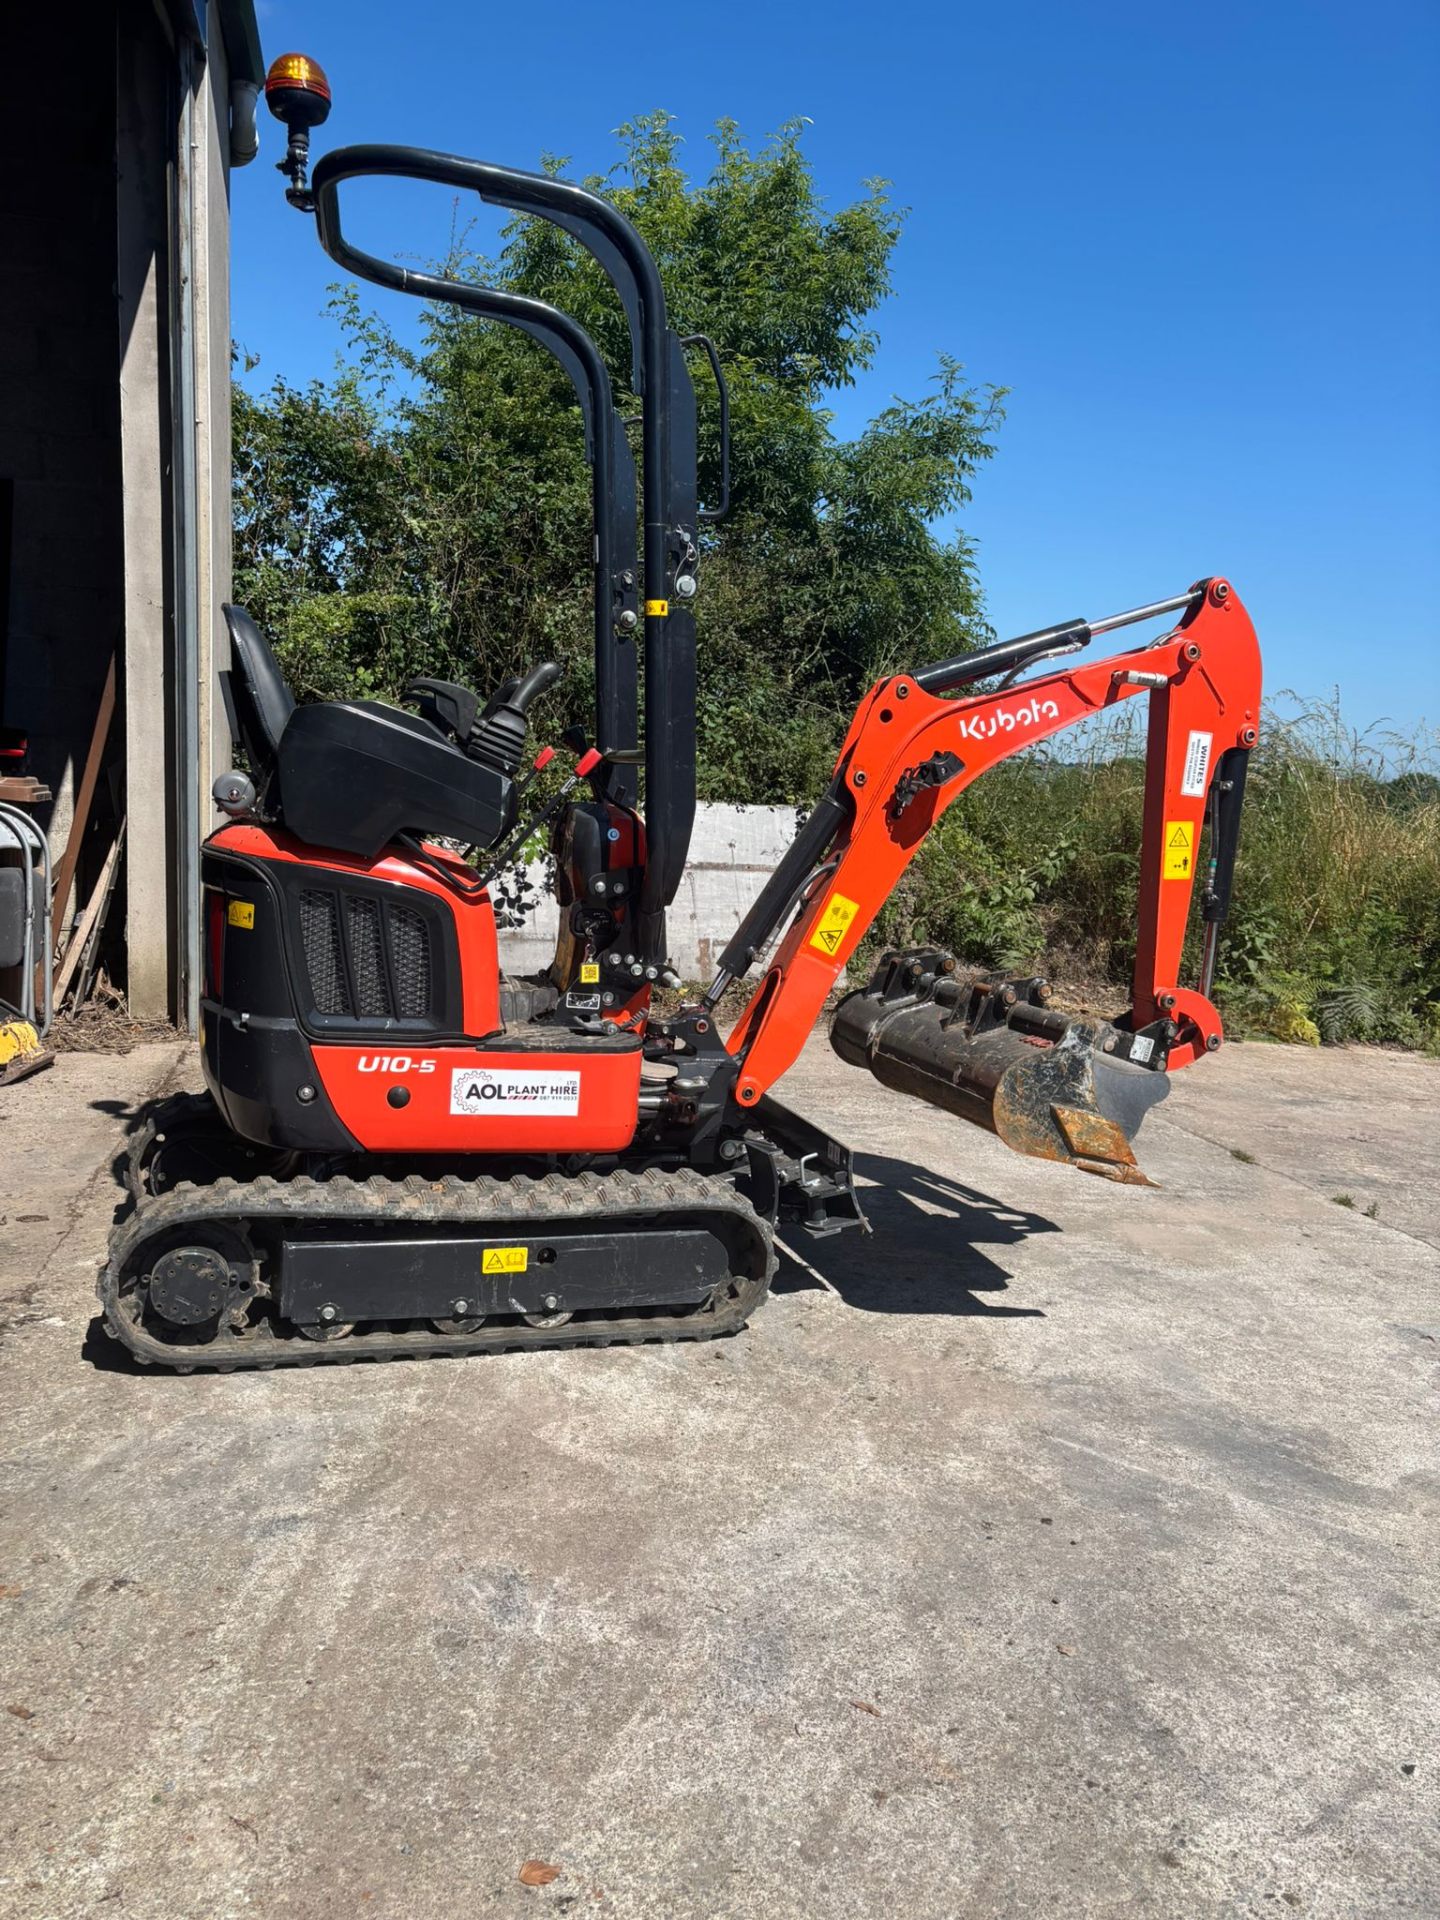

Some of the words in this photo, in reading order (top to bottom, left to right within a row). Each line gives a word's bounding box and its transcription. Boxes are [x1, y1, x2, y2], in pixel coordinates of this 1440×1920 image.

[960, 698, 1059, 740] Kubota
[1197, 745, 1208, 784] WHITES
[357, 1056, 437, 1073] U10-5
[466, 1083, 507, 1100] AOL
[507, 1085, 547, 1095] PLANT
[550, 1085, 578, 1095] HIRE
